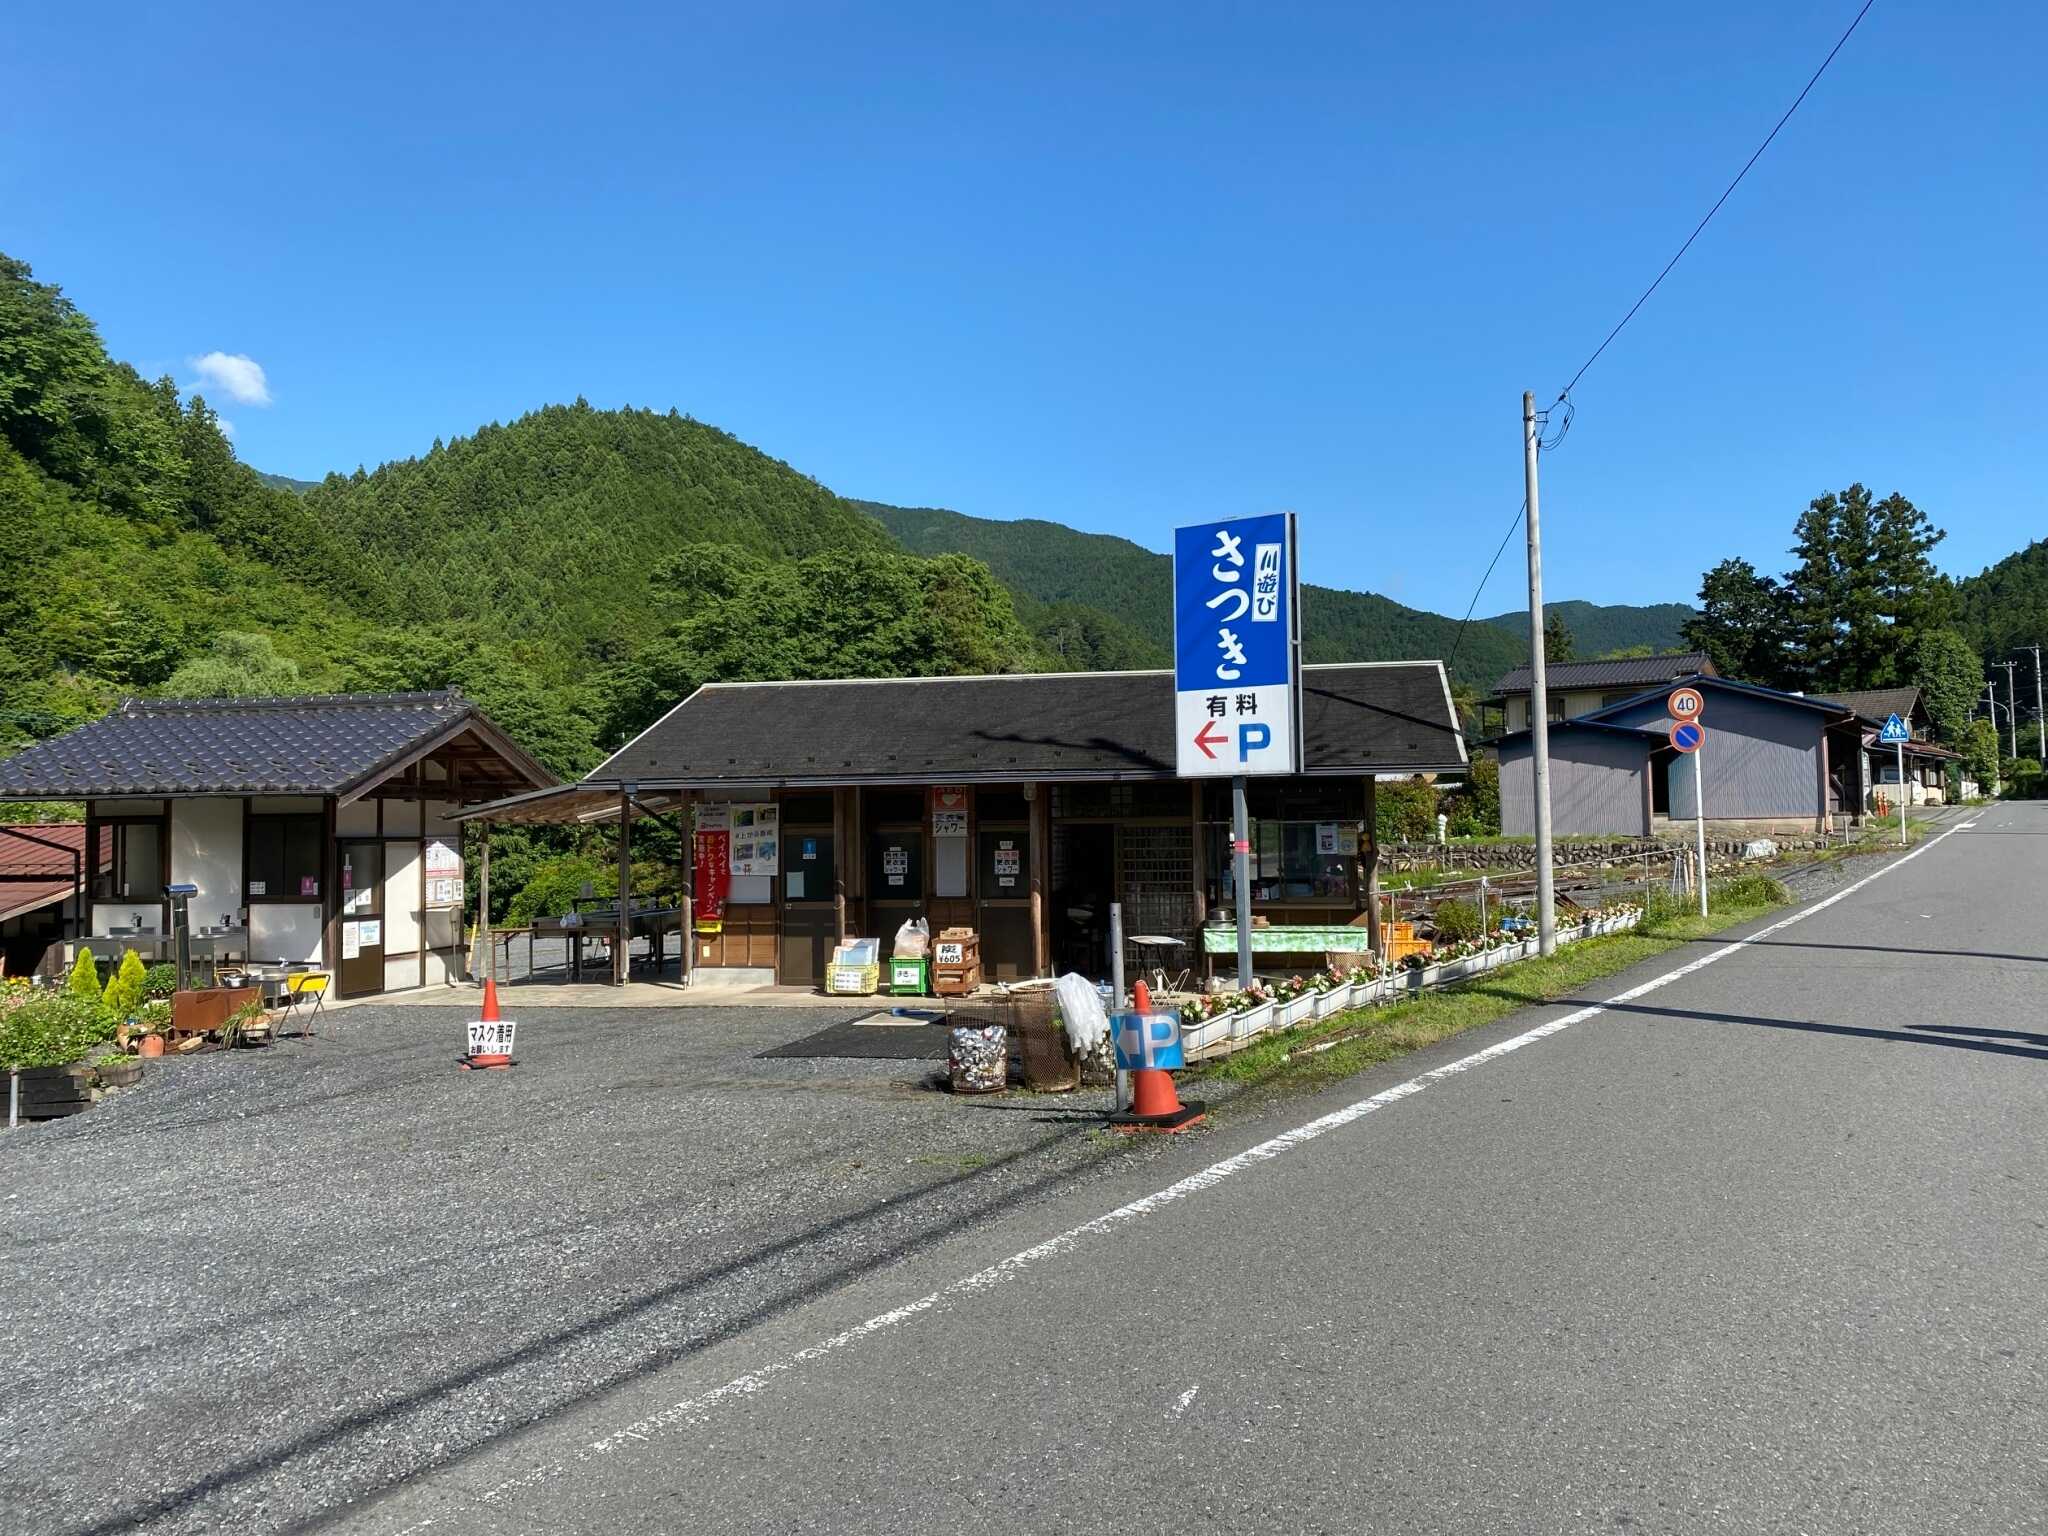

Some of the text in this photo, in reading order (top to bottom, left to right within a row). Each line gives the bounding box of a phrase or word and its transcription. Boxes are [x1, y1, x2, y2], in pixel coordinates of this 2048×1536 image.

[1256, 549, 1278, 616] 川遊び
[1205, 529, 1250, 681] さつき
[1206, 692, 1258, 718] 有料
[1677, 697, 1695, 712] 40
[1238, 722, 1271, 763] P
[935, 823, 966, 834] シャワー
[469, 1023, 514, 1043] マスク着用
[1142, 1015, 1179, 1067] P
[470, 1044, 510, 1055] お願いします
